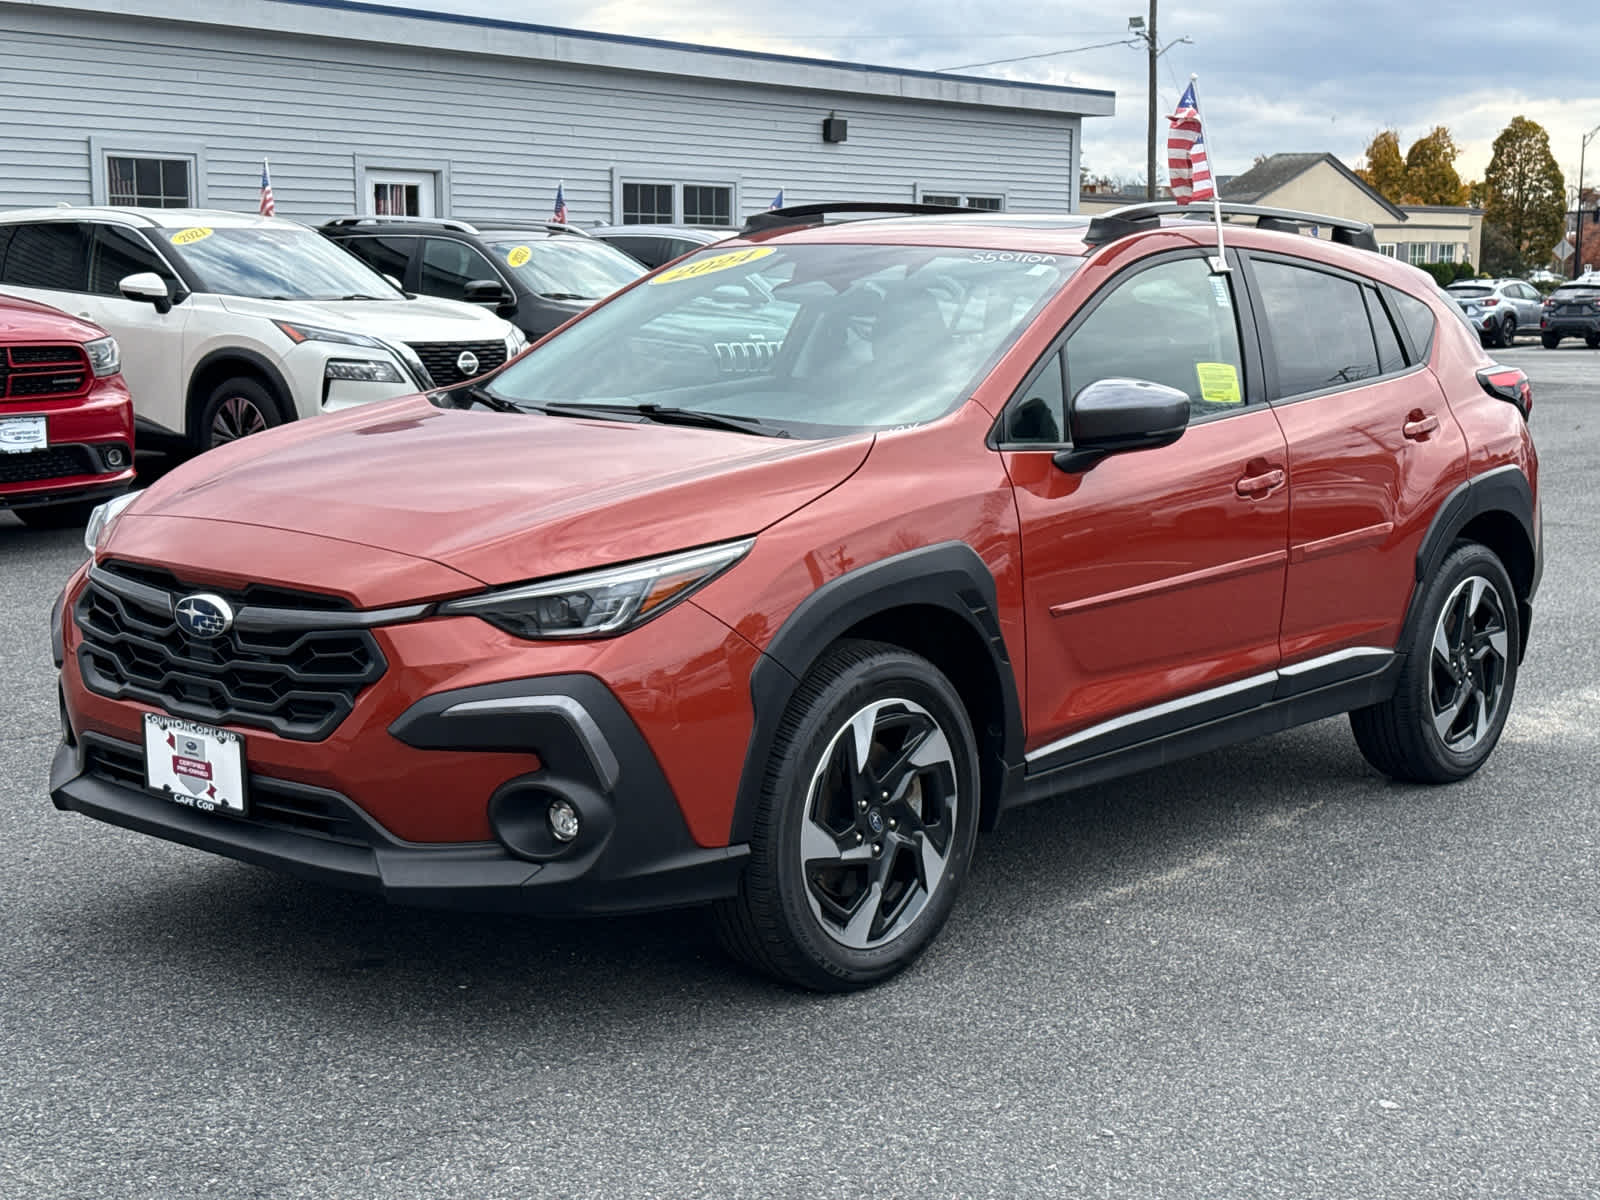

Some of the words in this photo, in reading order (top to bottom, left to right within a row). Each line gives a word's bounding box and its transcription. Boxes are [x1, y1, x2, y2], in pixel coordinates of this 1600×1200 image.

[178, 228, 207, 243] 2021
[667, 249, 758, 281] 2024
[176, 765, 209, 777] PRE-OWNED
[178, 759, 206, 770] CERTIFIED
[174, 793, 195, 807] CAPE
[196, 799, 215, 811] COD
